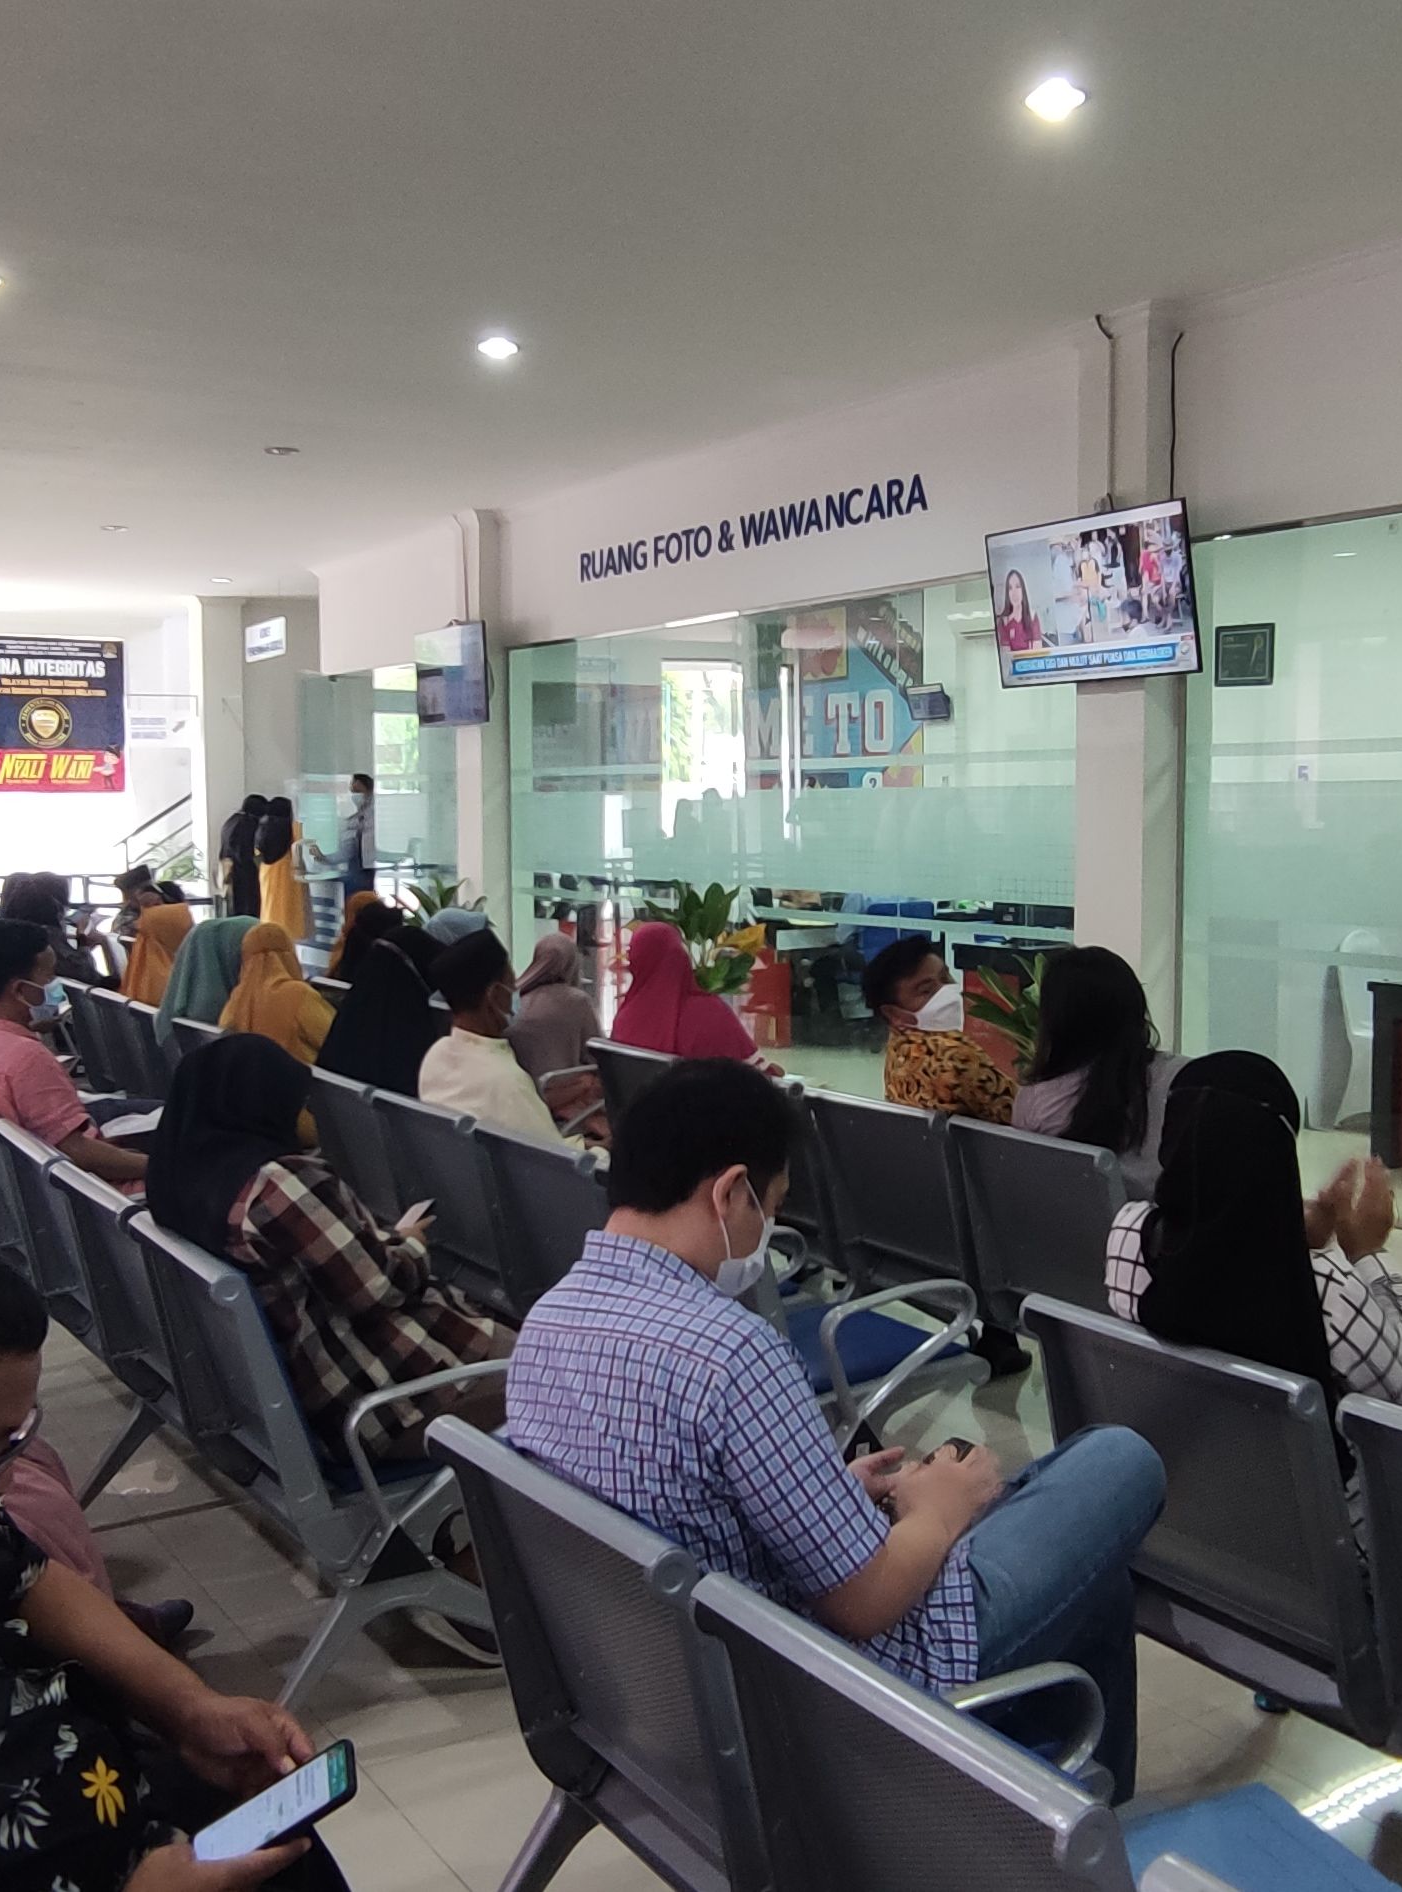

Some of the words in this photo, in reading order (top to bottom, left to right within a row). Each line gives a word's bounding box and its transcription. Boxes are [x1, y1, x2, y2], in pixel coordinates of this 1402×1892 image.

[580, 539, 648, 583] RUANG
[653, 525, 712, 568] FOTO
[717, 519, 735, 553] &
[739, 473, 929, 549] WAWANCARA
[23, 658, 106, 678] INTEGRITAS
[826, 688, 895, 756] TO
